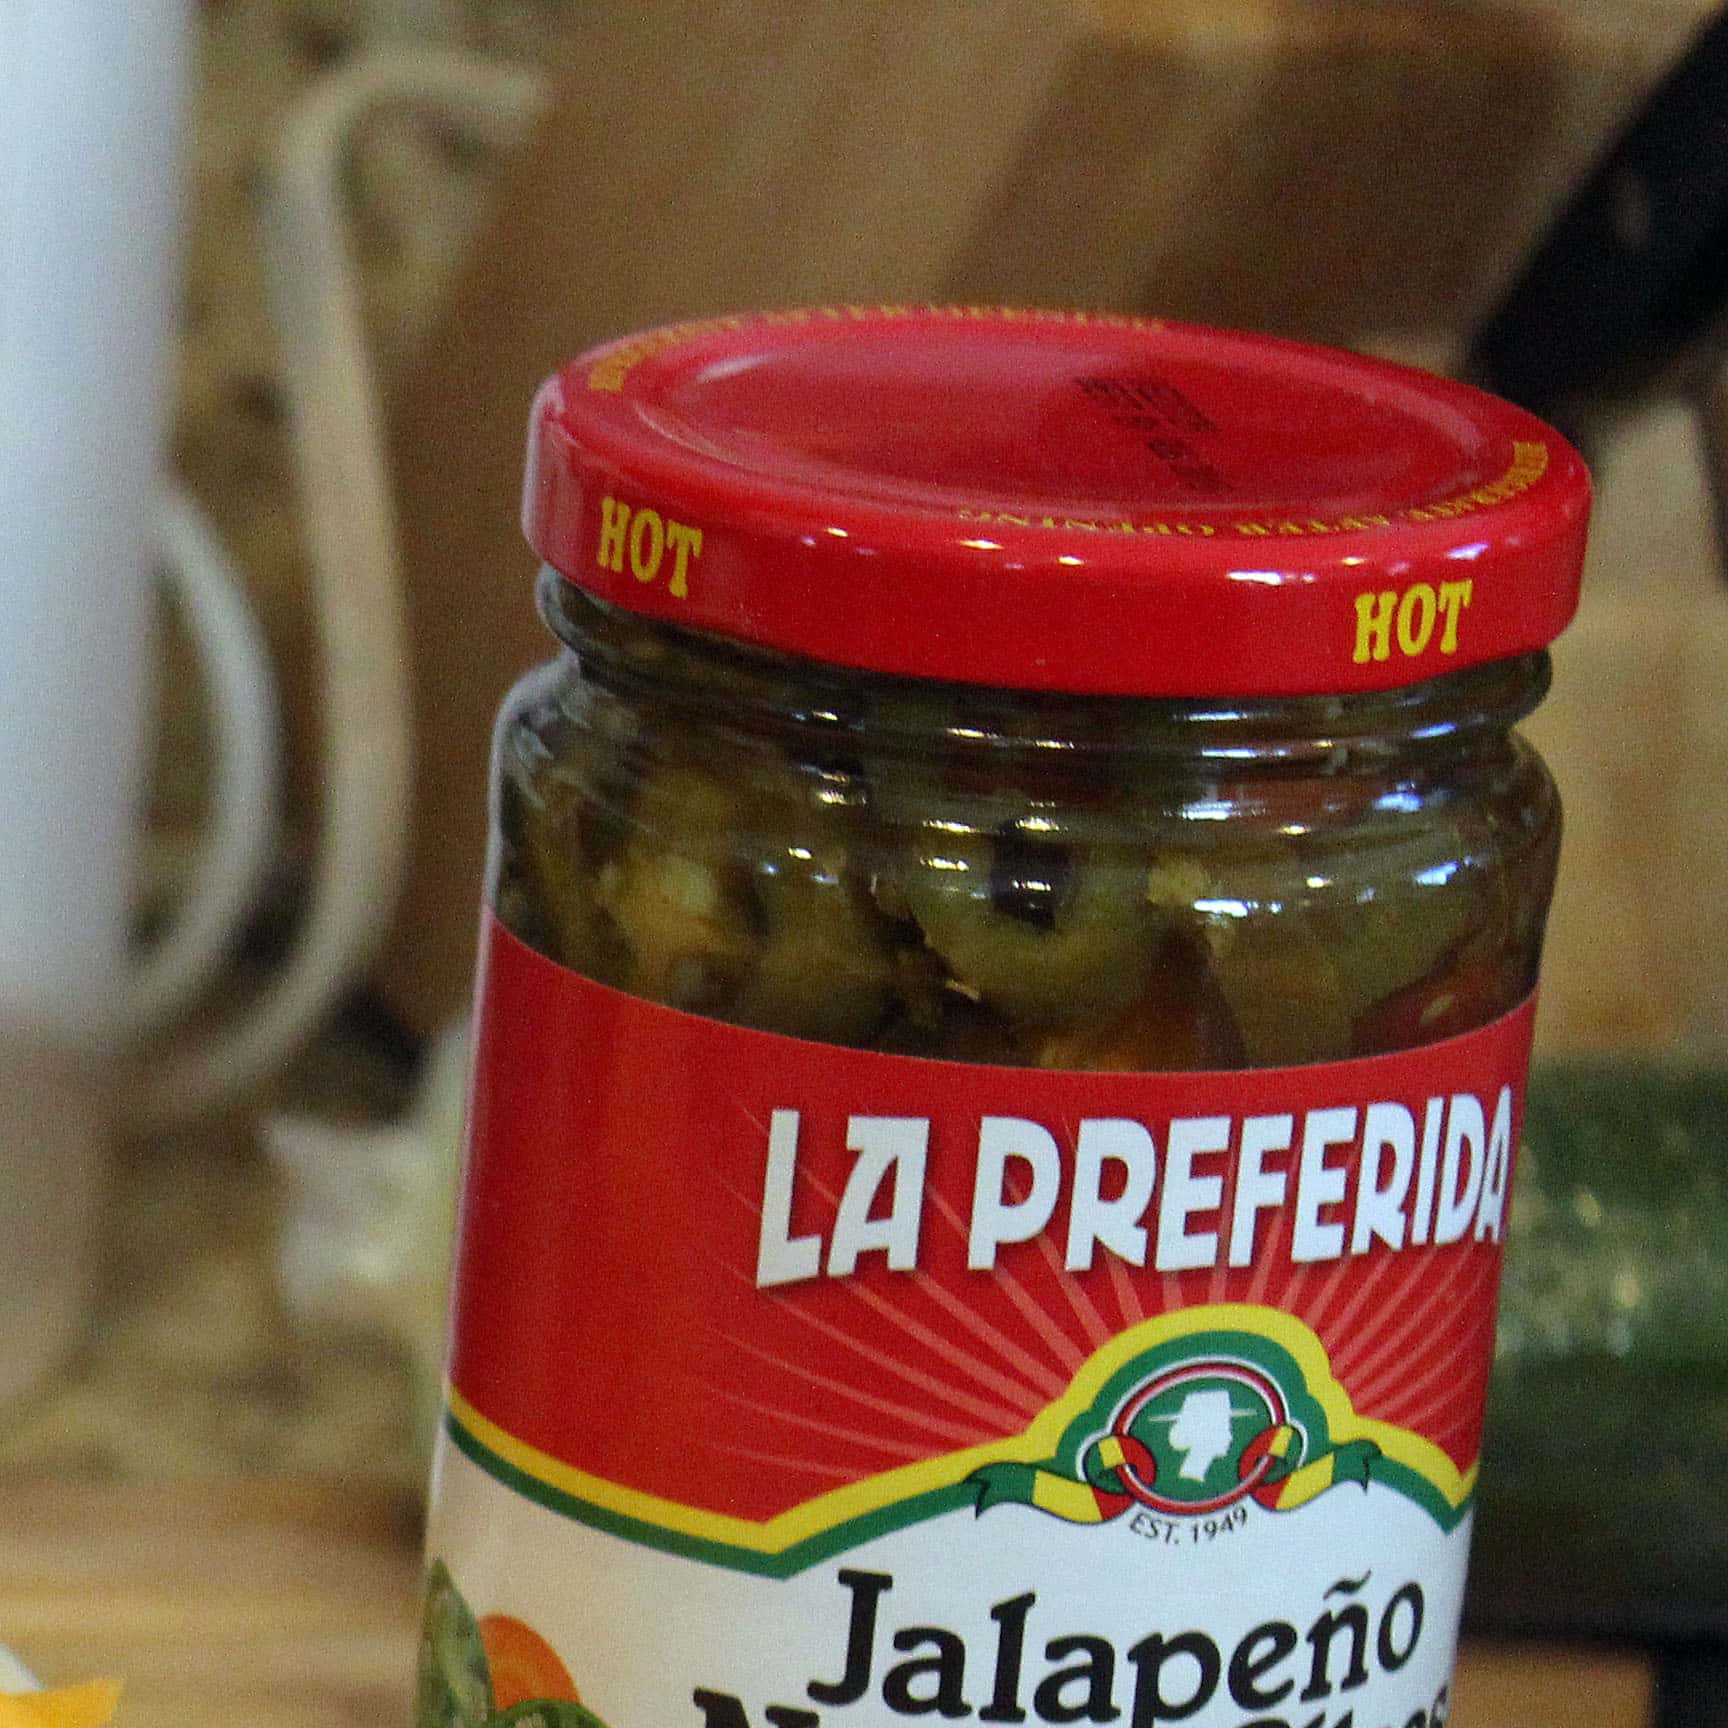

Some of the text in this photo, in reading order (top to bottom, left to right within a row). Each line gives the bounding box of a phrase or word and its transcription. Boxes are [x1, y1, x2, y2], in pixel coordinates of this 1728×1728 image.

[597, 495, 703, 600] HOT
[1352, 577, 1473, 664] HOT
[756, 1083, 1513, 1289] LA PREFERIDA
[1130, 1503, 1248, 1545] EST. 1949
